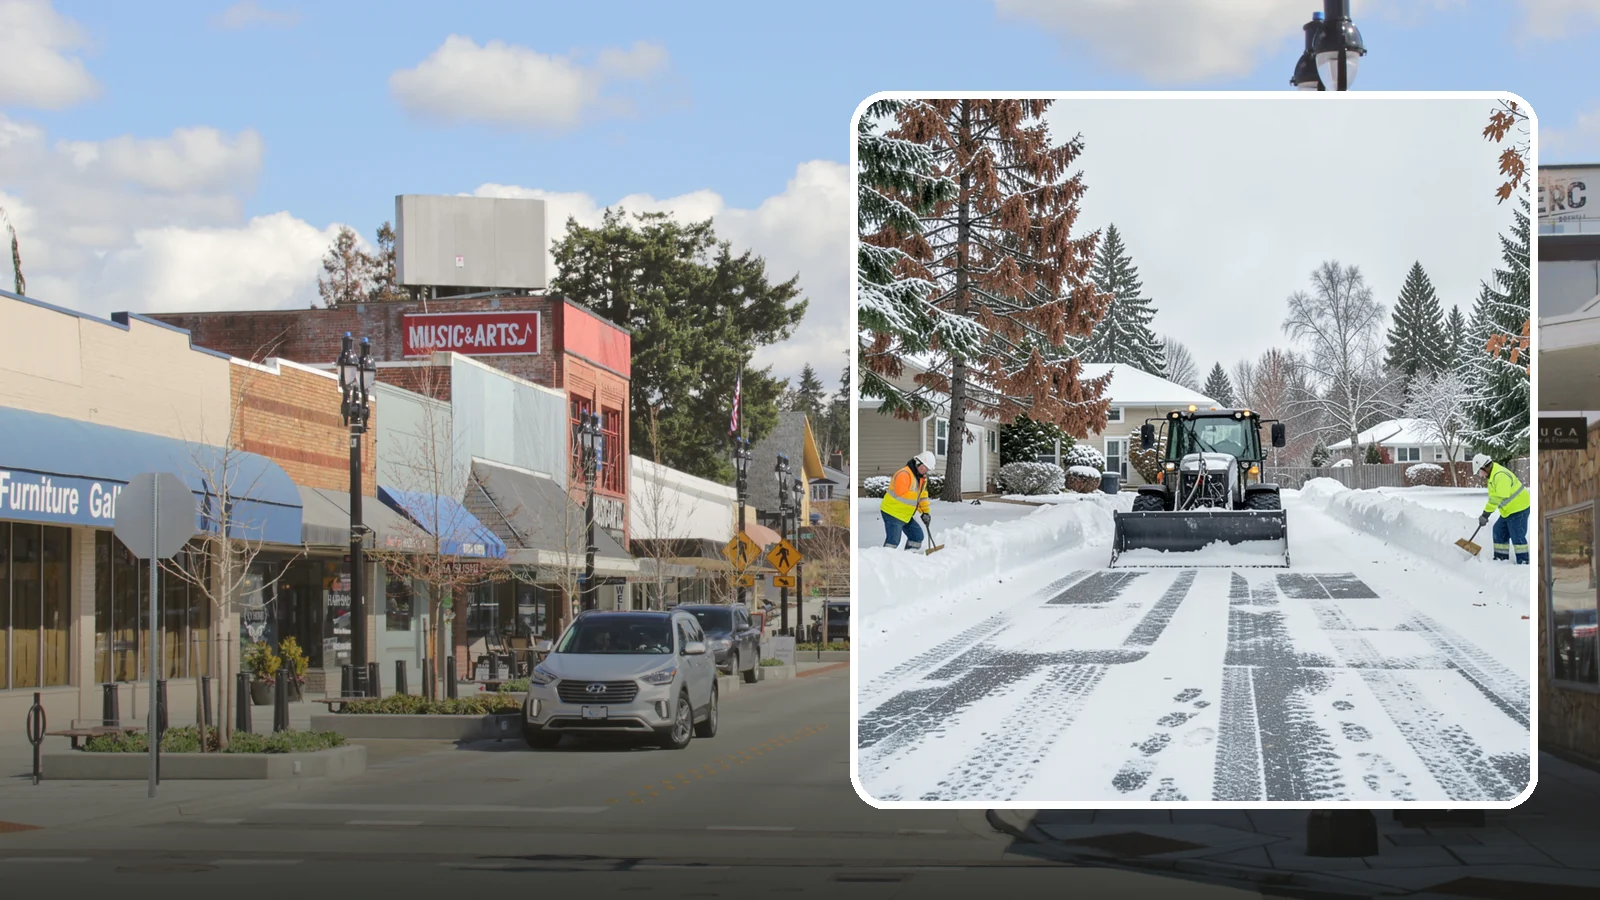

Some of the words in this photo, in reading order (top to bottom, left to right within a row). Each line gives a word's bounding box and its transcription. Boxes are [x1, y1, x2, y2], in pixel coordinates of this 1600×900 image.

[409, 323, 520, 349] MUSIC&ARTS
[1540, 427, 1577, 436] UGA
[0, 472, 79, 515] Furniture
[89, 482, 122, 519] Gal
